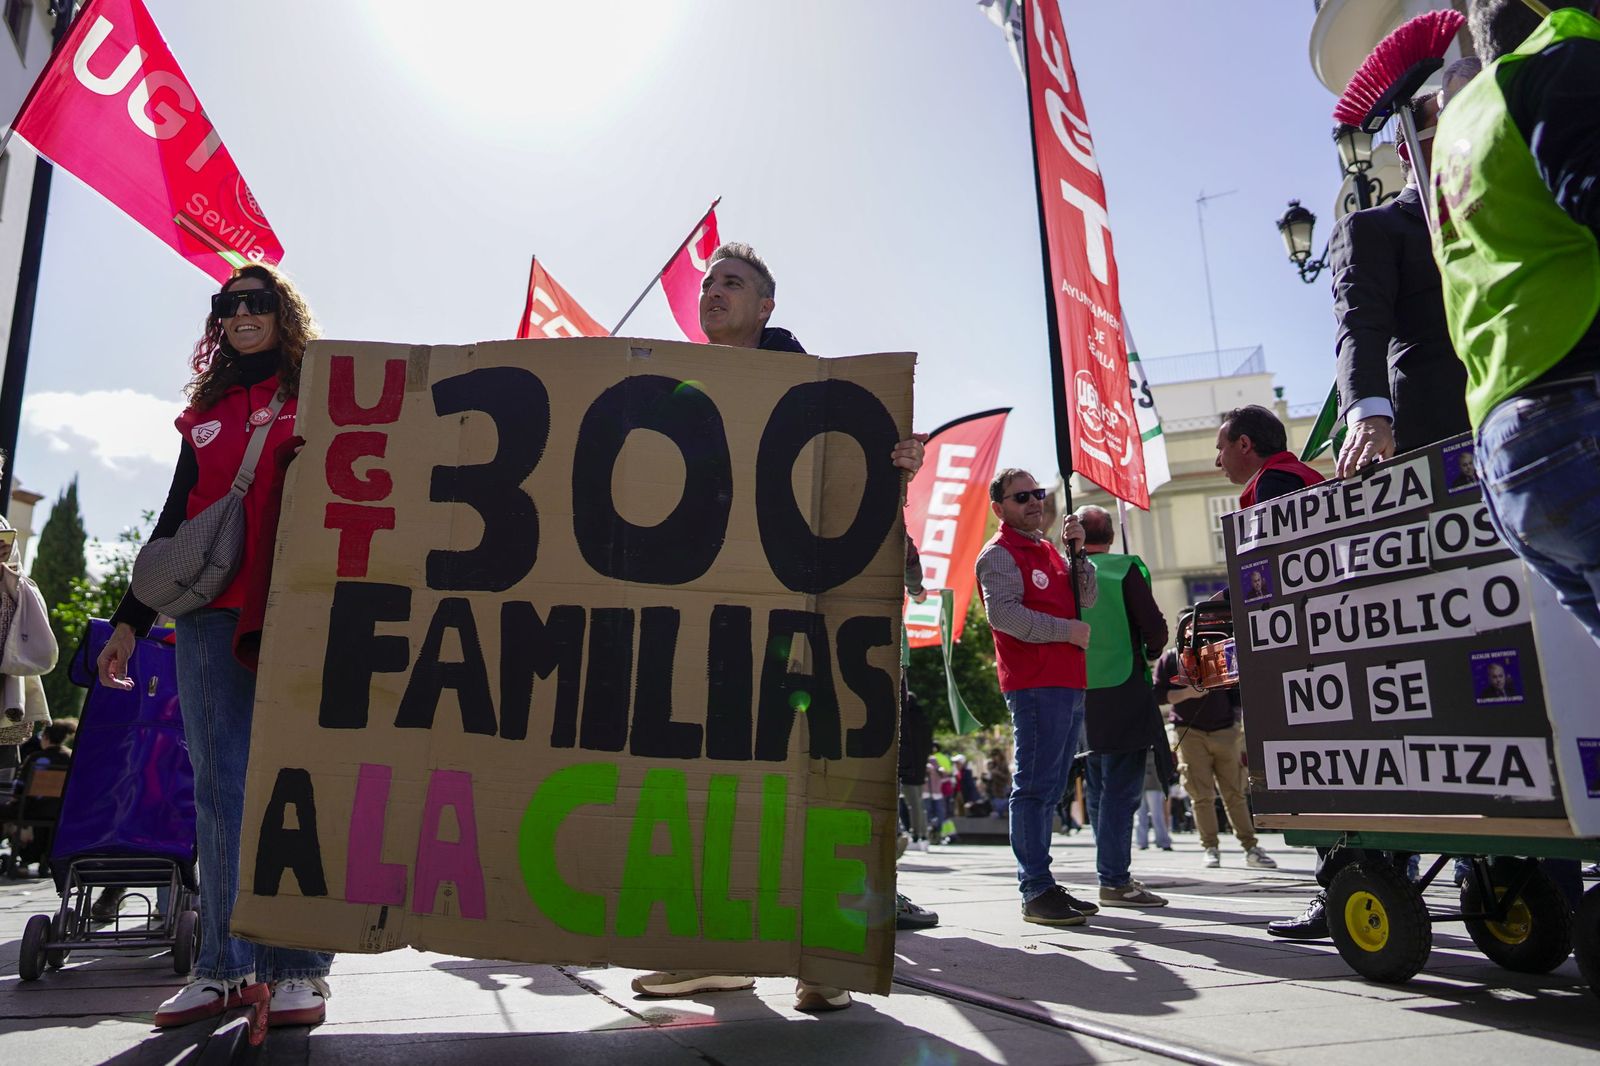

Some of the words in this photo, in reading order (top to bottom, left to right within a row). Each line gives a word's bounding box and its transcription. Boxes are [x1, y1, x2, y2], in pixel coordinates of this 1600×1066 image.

[186, 193, 265, 263] Sevilla
[324, 355, 406, 578] UGT
[426, 366, 900, 594] 300
[1238, 466, 1428, 545] LIMPIEZA
[1281, 507, 1500, 588] COLEGIOS
[1251, 609, 1293, 647] LO
[1310, 575, 1520, 647] PÚBLICO
[319, 582, 896, 761] FAMILIAS
[1288, 673, 1344, 714] NO
[1372, 672, 1427, 715] SE
[1277, 744, 1536, 788] PRIVATIZA
[254, 767, 328, 897] A
[345, 763, 487, 919] LA
[518, 763, 872, 955] CALLE
